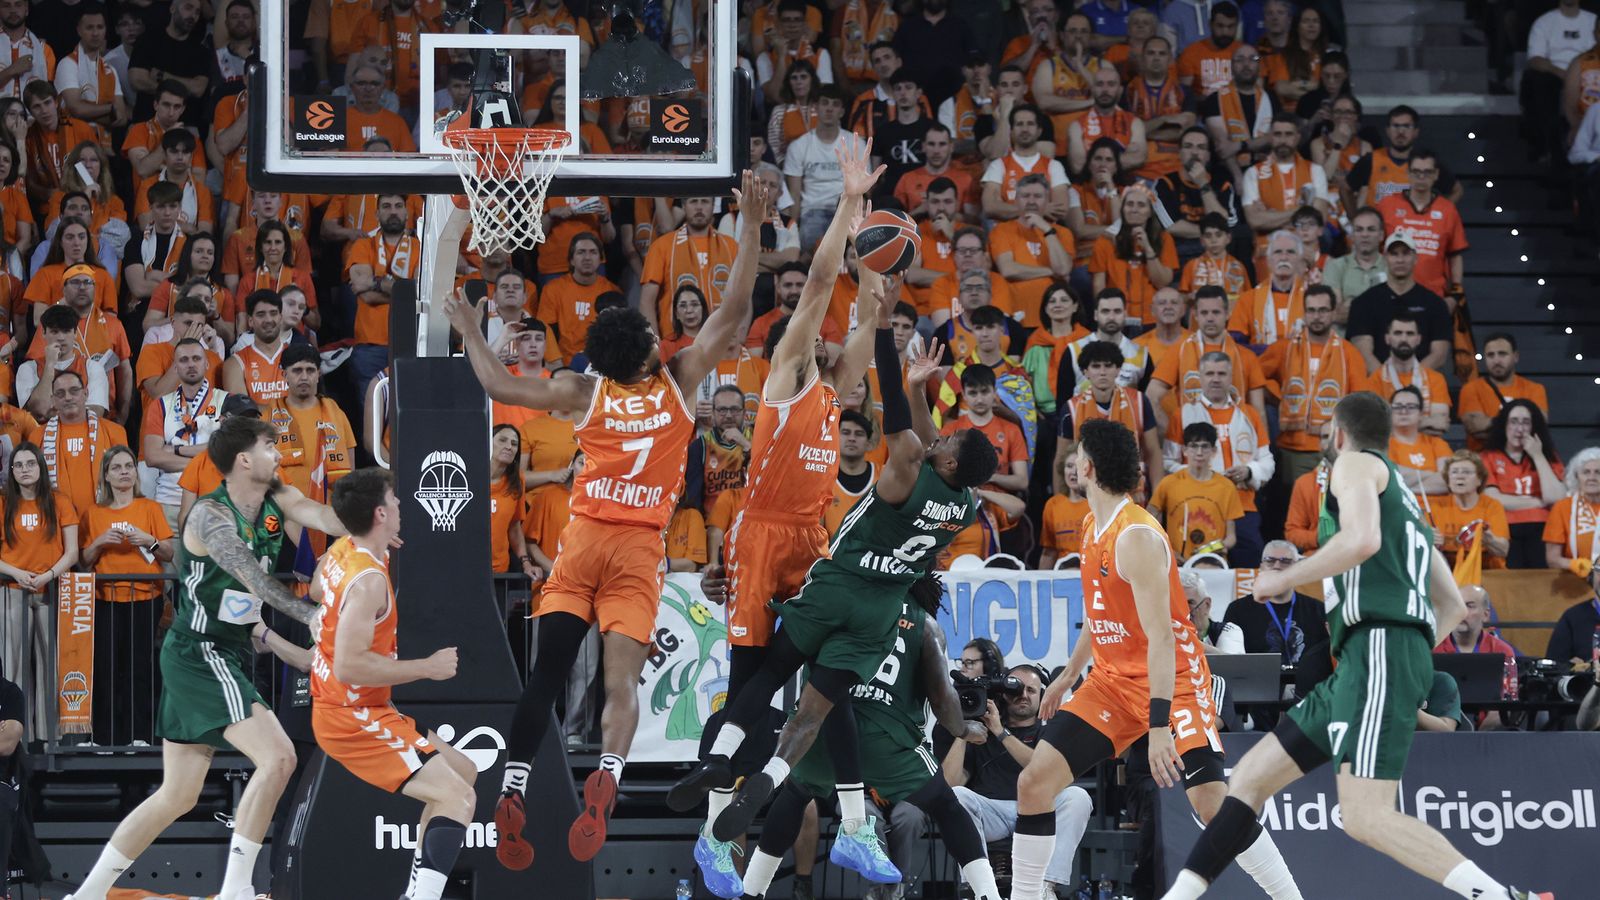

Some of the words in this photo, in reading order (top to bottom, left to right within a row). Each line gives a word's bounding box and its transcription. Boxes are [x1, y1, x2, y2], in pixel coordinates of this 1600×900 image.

[295, 132, 345, 143] EuroLeague
[651, 135, 700, 146] EuroLeague
[604, 389, 665, 415] KEY
[604, 411, 672, 433] PAMESA
[621, 437, 655, 480] 7
[586, 477, 663, 508] VALENCIA
[1515, 475, 1532, 495] 17
[893, 534, 937, 562] 0
[1405, 520, 1430, 597] 17
[1174, 709, 1197, 740] 2
